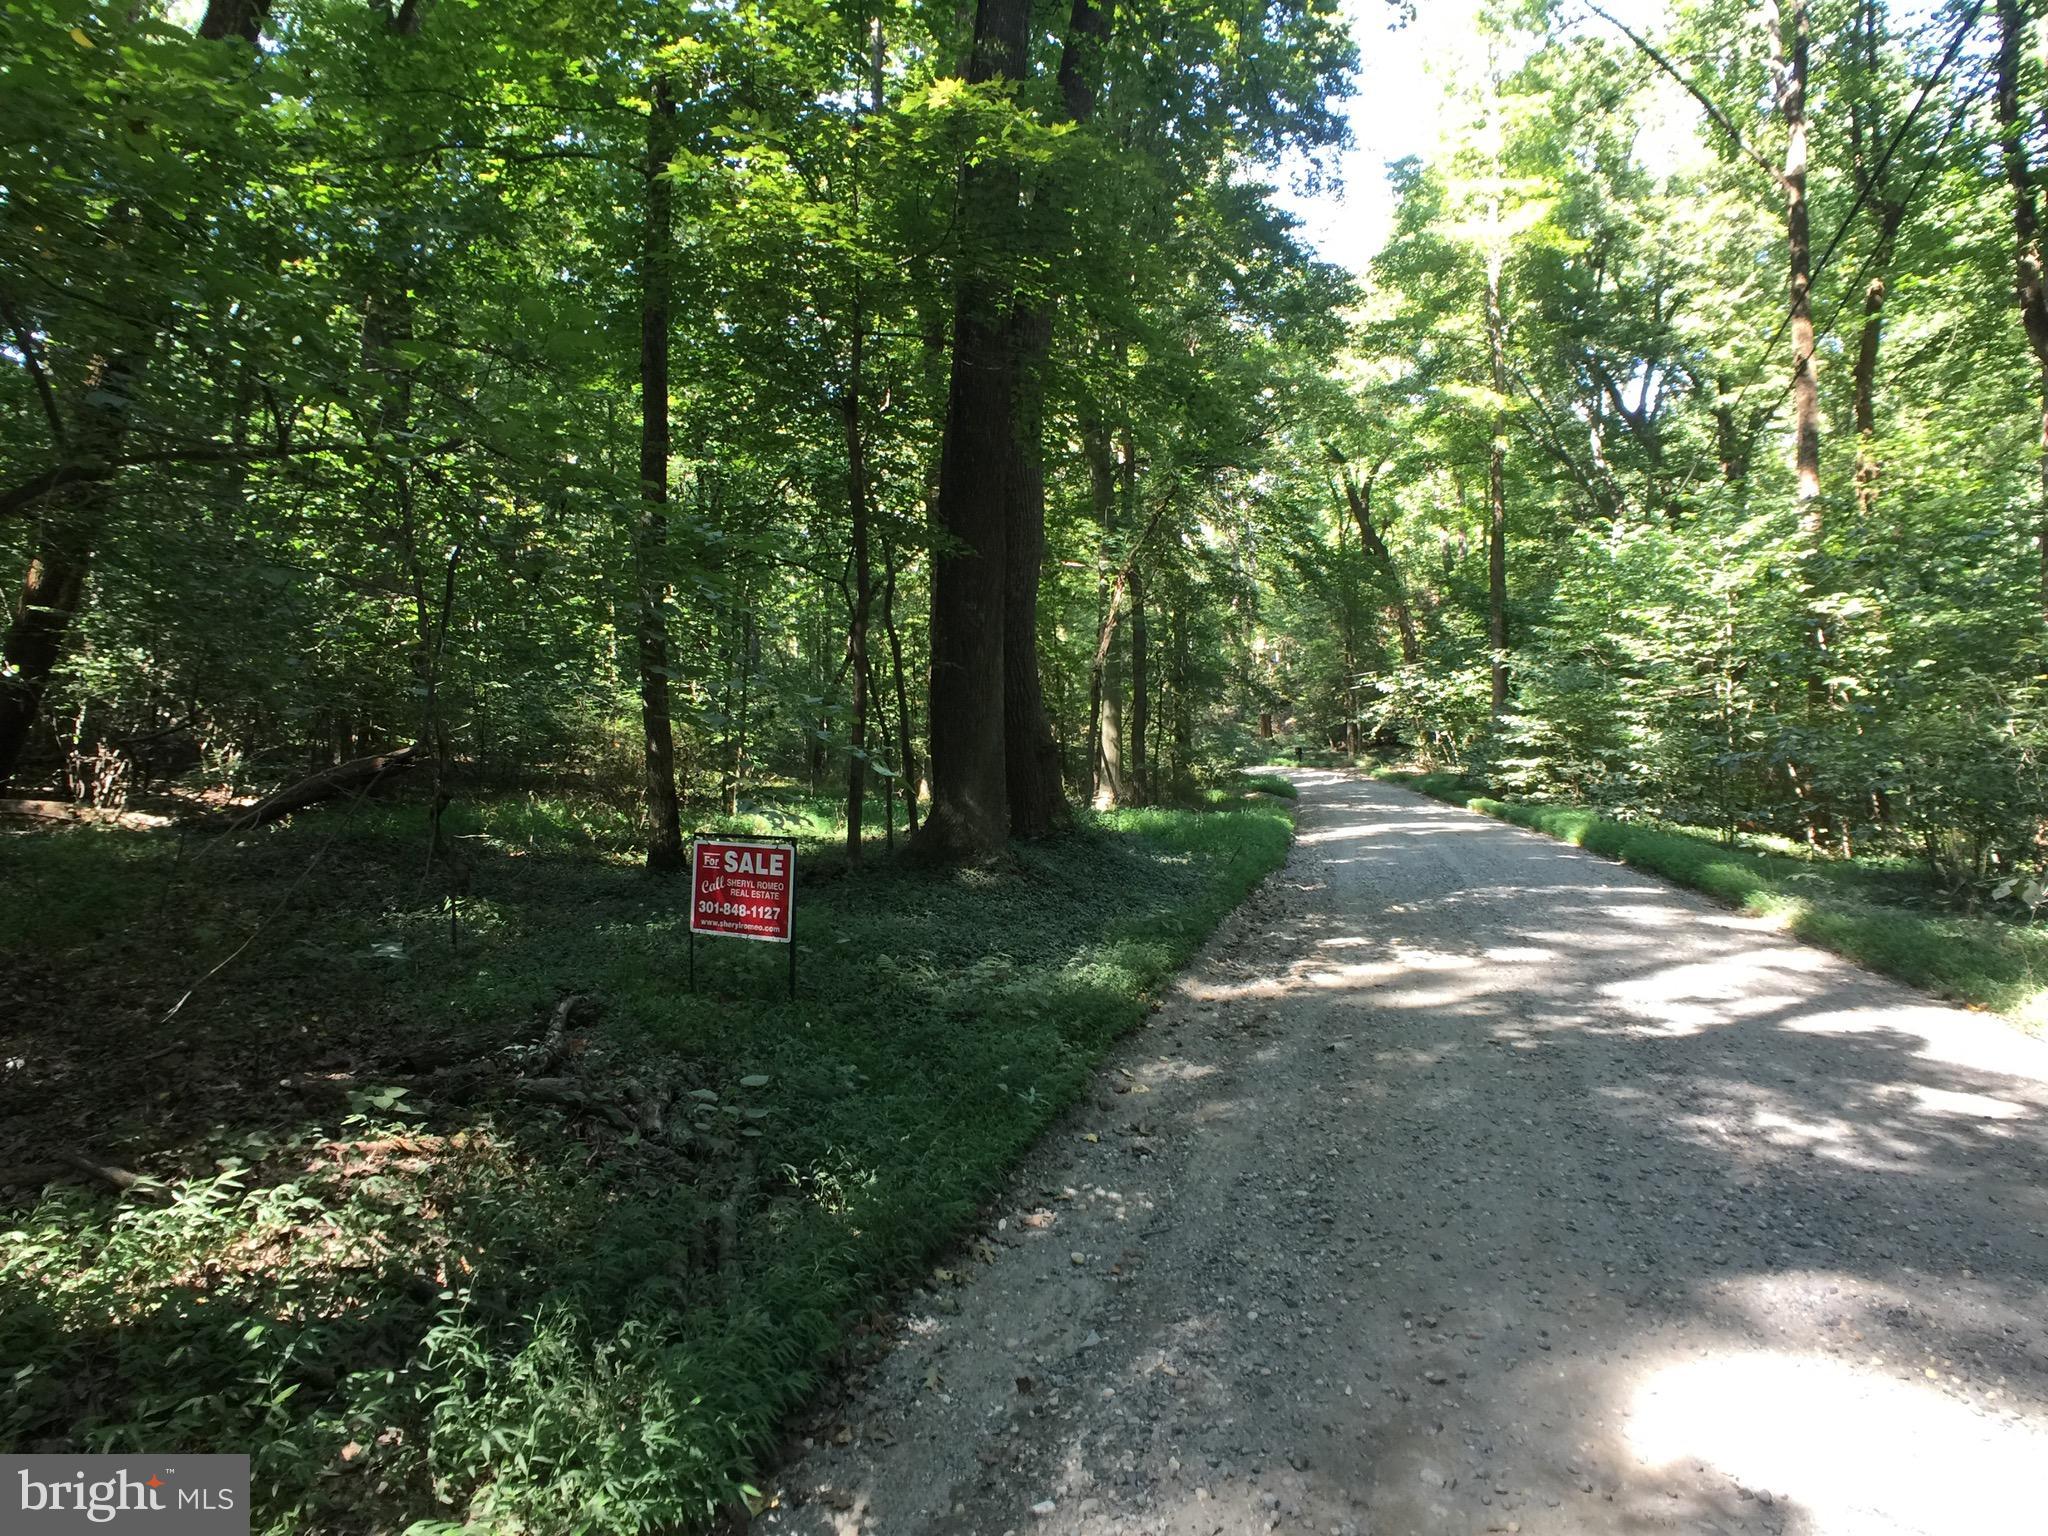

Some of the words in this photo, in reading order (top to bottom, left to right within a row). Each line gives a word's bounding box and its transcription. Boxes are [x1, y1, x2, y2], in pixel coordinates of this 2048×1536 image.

[704, 855, 719, 866] For
[724, 850, 784, 877] SALE
[701, 875, 725, 894] Call
[727, 878, 755, 889] SHERYL
[757, 880, 784, 891] ROMEO
[730, 888, 750, 898] REAL
[751, 890, 780, 901] ESTATE
[698, 900, 781, 920] 301-848-1127
[700, 919, 780, 933] www.sherylromeo.com
